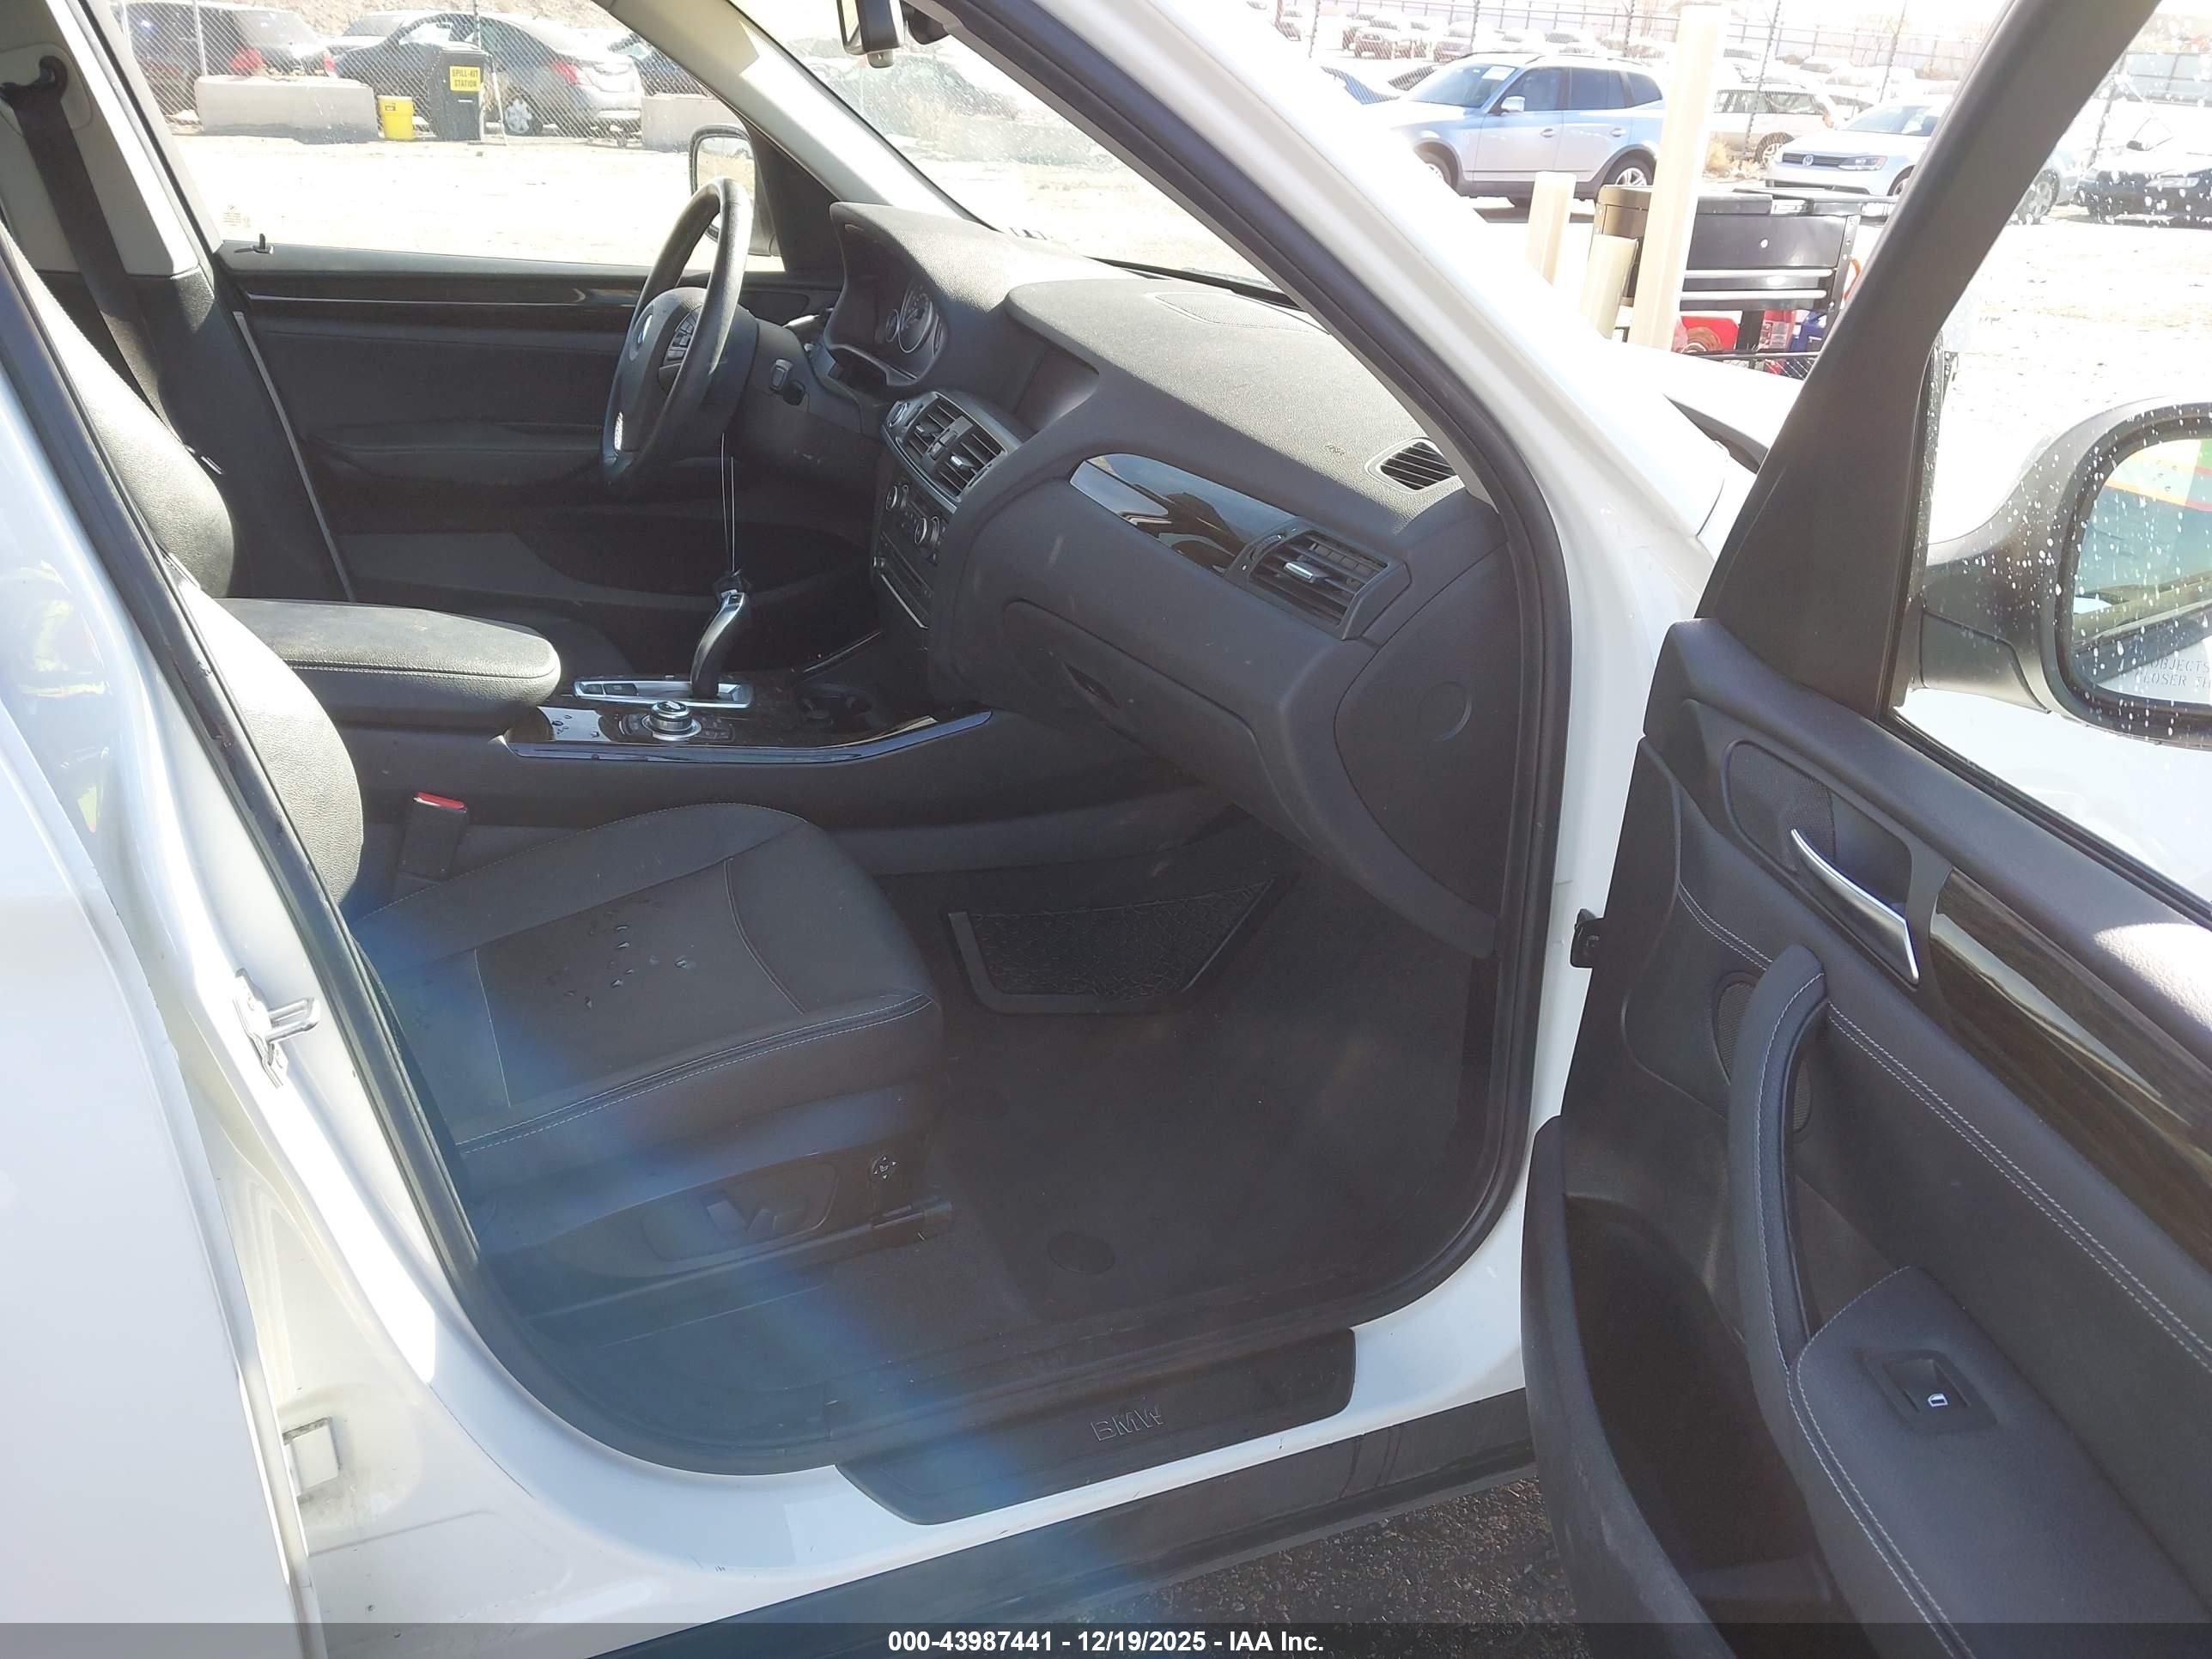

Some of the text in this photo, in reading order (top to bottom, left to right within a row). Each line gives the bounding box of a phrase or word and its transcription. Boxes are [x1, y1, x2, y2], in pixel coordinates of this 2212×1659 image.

[2150, 658, 2209, 673] OBJECTS
[2136, 671, 2186, 686] CLOSER
[1091, 1406, 1164, 1442] BMW
